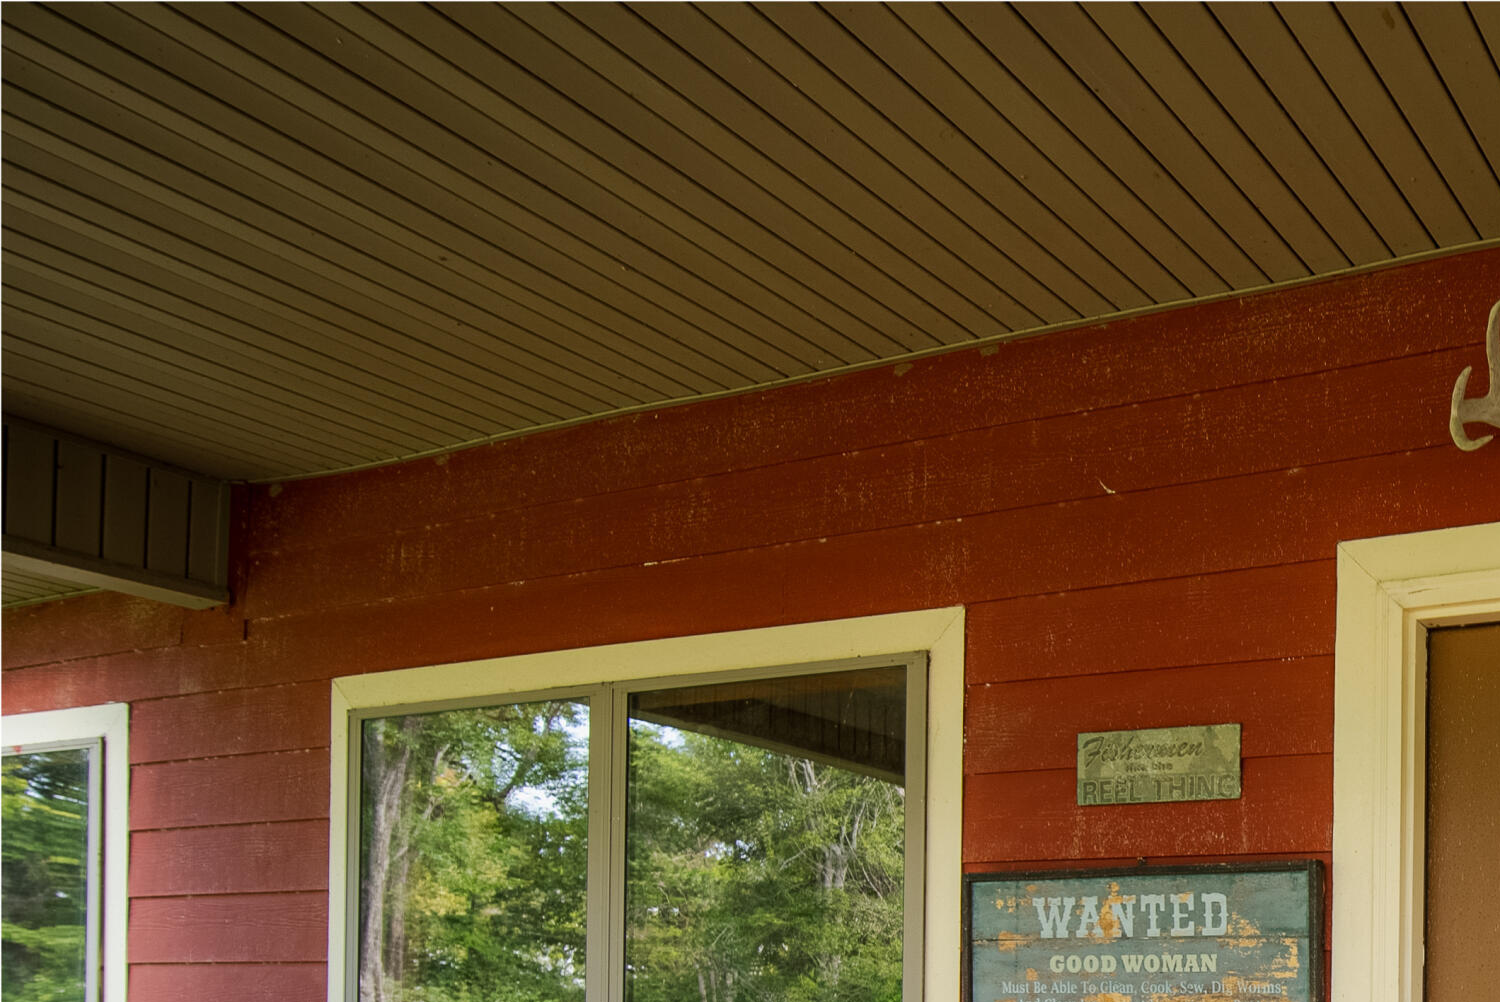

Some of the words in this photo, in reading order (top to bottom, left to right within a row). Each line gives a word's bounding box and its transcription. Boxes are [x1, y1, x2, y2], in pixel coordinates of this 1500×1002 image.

[1082, 778, 1142, 804] REEL
[1154, 773, 1236, 800] THING
[1032, 892, 1228, 939] WANTED
[1050, 954, 1117, 973] GOOD
[1121, 953, 1217, 973] WOMAN
[1002, 981, 1029, 994] Must
[1033, 981, 1047, 994] Be
[1050, 981, 1077, 994] Able
[1080, 981, 1096, 994] To
[1100, 981, 1137, 995] Clean,
[1141, 981, 1176, 995] Cook,
[1211, 981, 1233, 996] Dig
